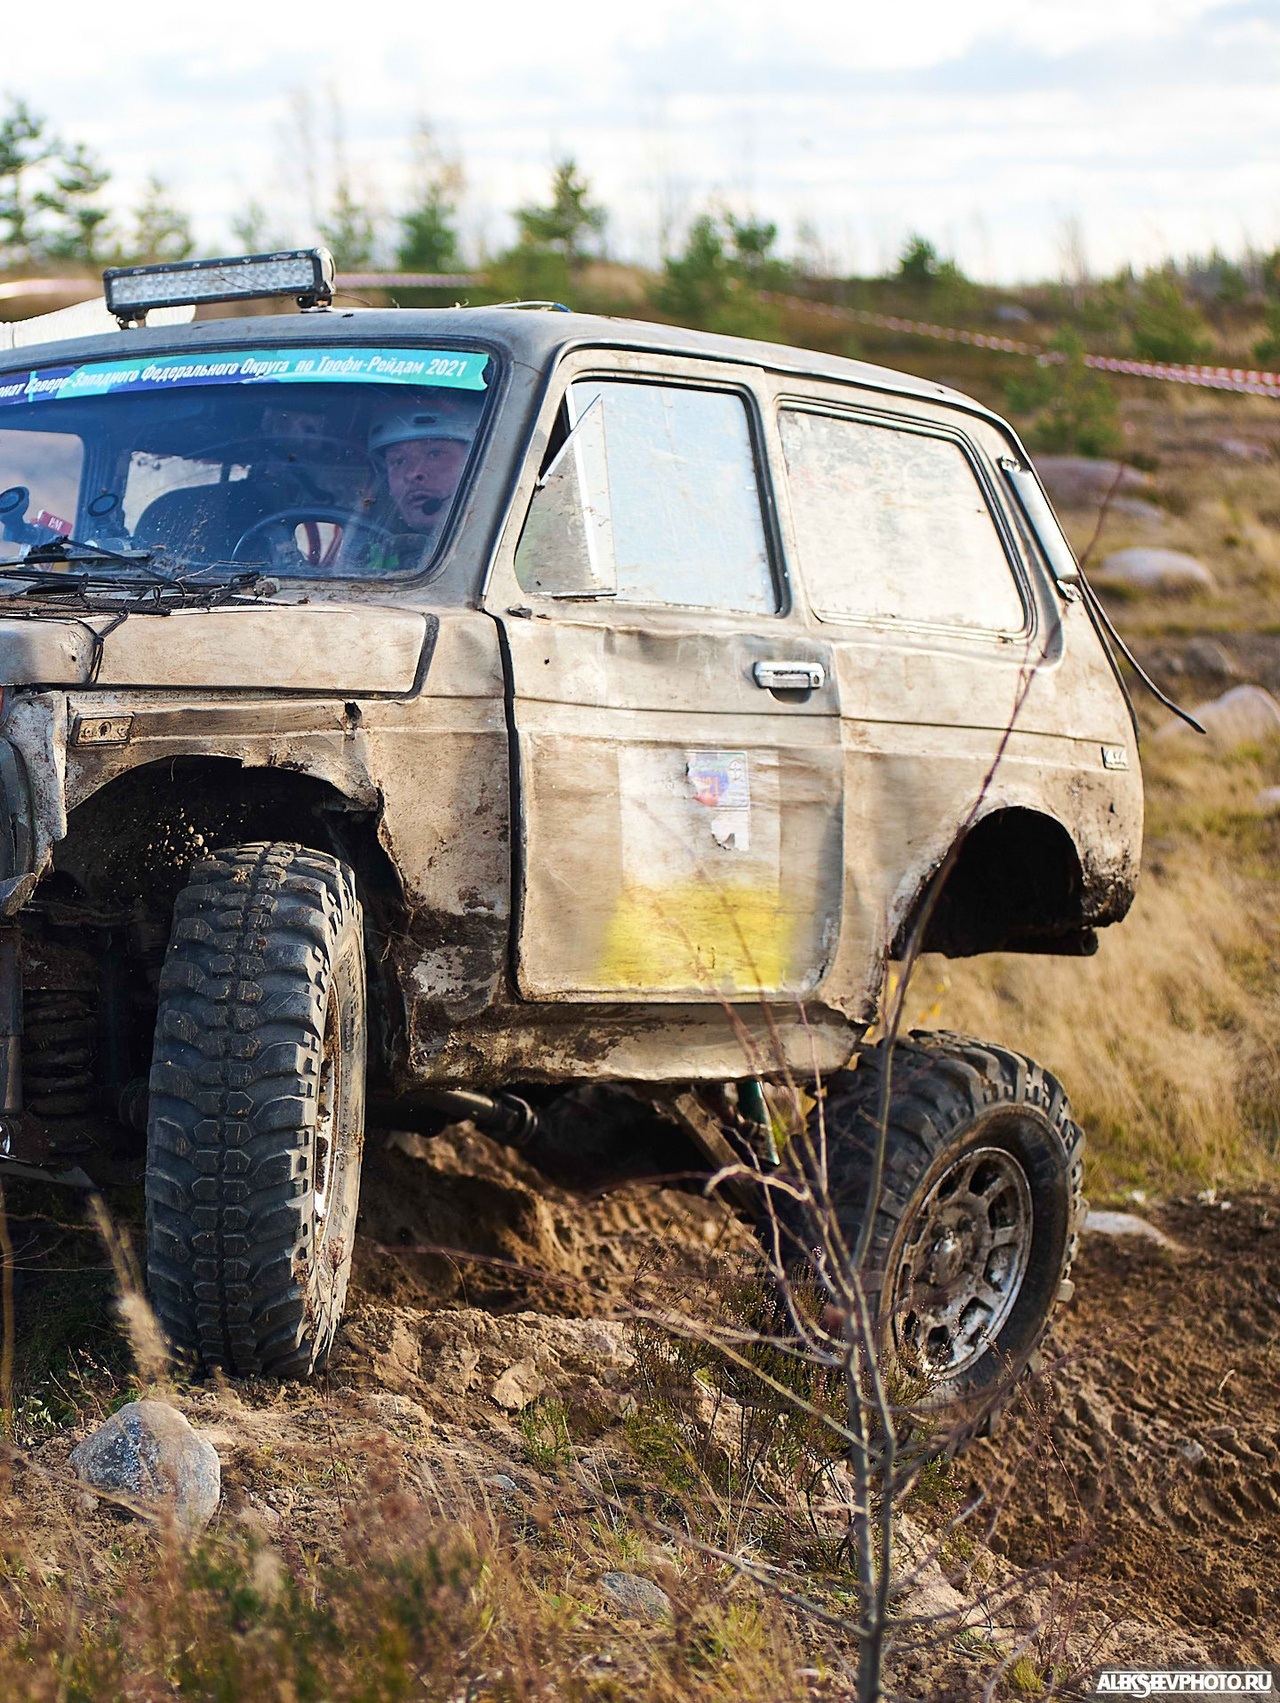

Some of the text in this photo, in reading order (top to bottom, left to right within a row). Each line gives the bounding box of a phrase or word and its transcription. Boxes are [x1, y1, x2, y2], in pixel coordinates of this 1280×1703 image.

[24, 369, 139, 394] Северо-Западного
[141, 364, 239, 382] Федерального
[240, 358, 290, 376] Округа
[295, 360, 315, 373] по
[318, 356, 425, 375] Трофи-Рейдам
[425, 359, 468, 377] 2021
